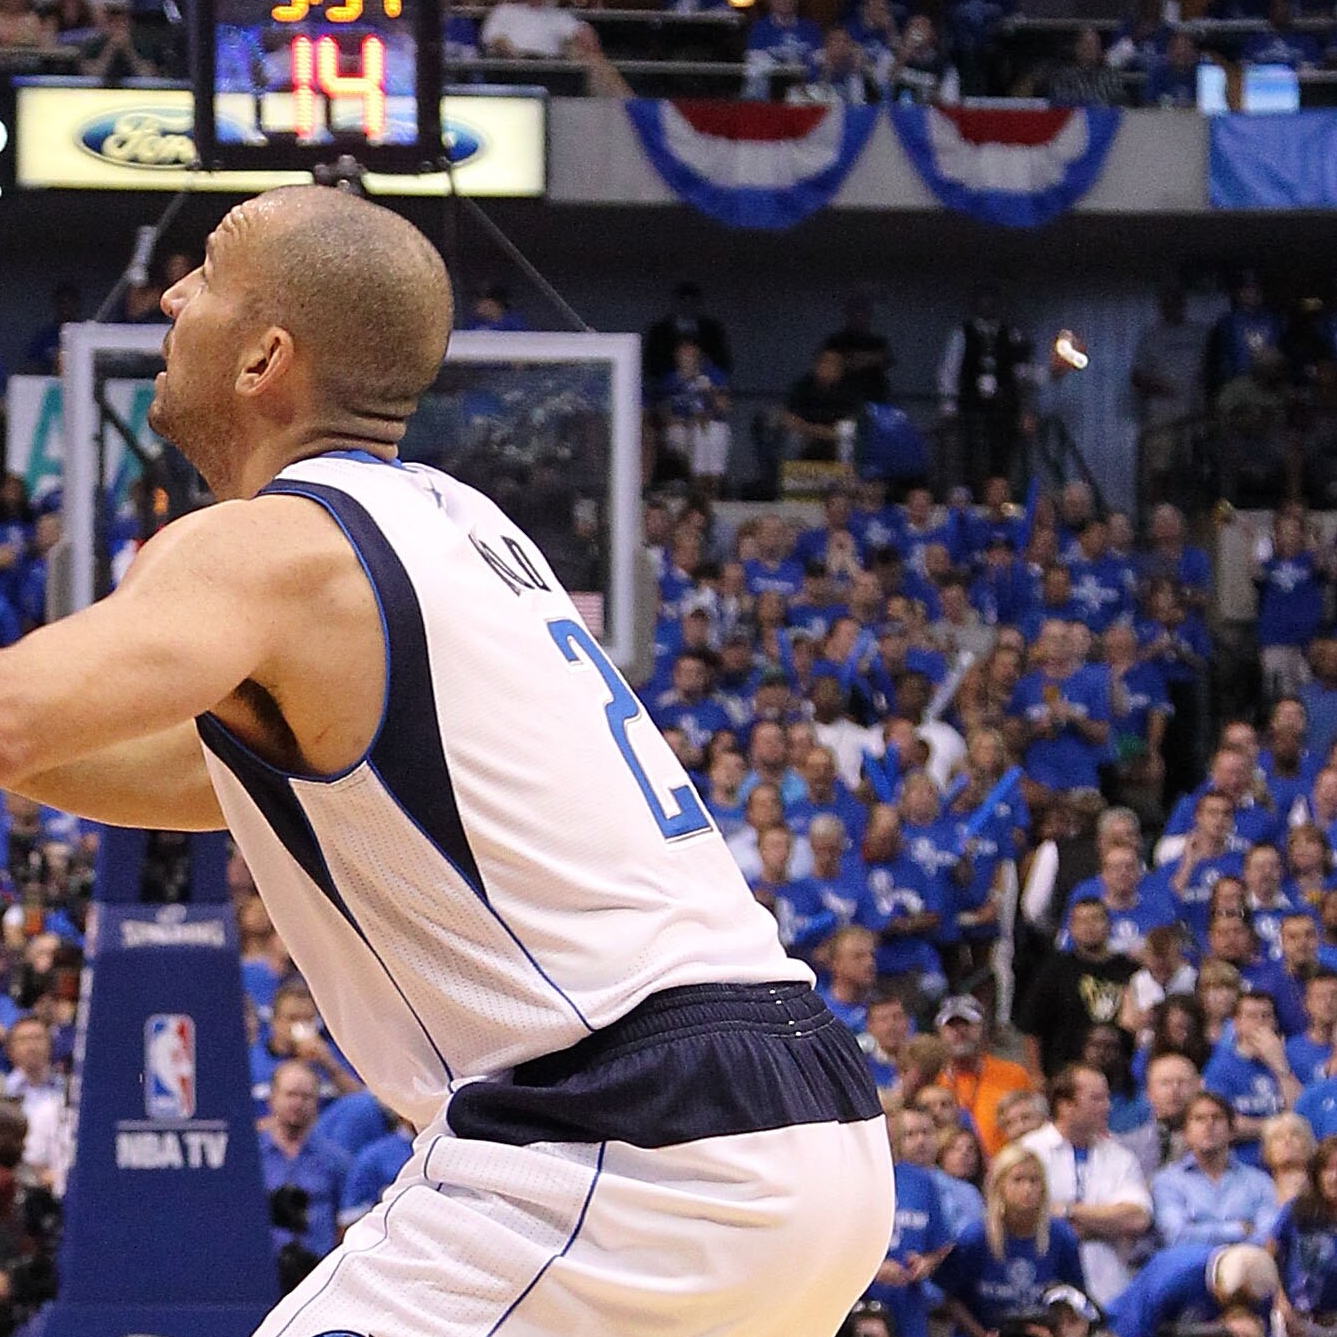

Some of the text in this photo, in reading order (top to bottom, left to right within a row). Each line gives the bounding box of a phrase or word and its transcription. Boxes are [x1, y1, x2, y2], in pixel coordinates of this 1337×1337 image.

[292, 34, 387, 141] 14
[545, 617, 713, 845] 2
[182, 1130, 229, 1170] TV
